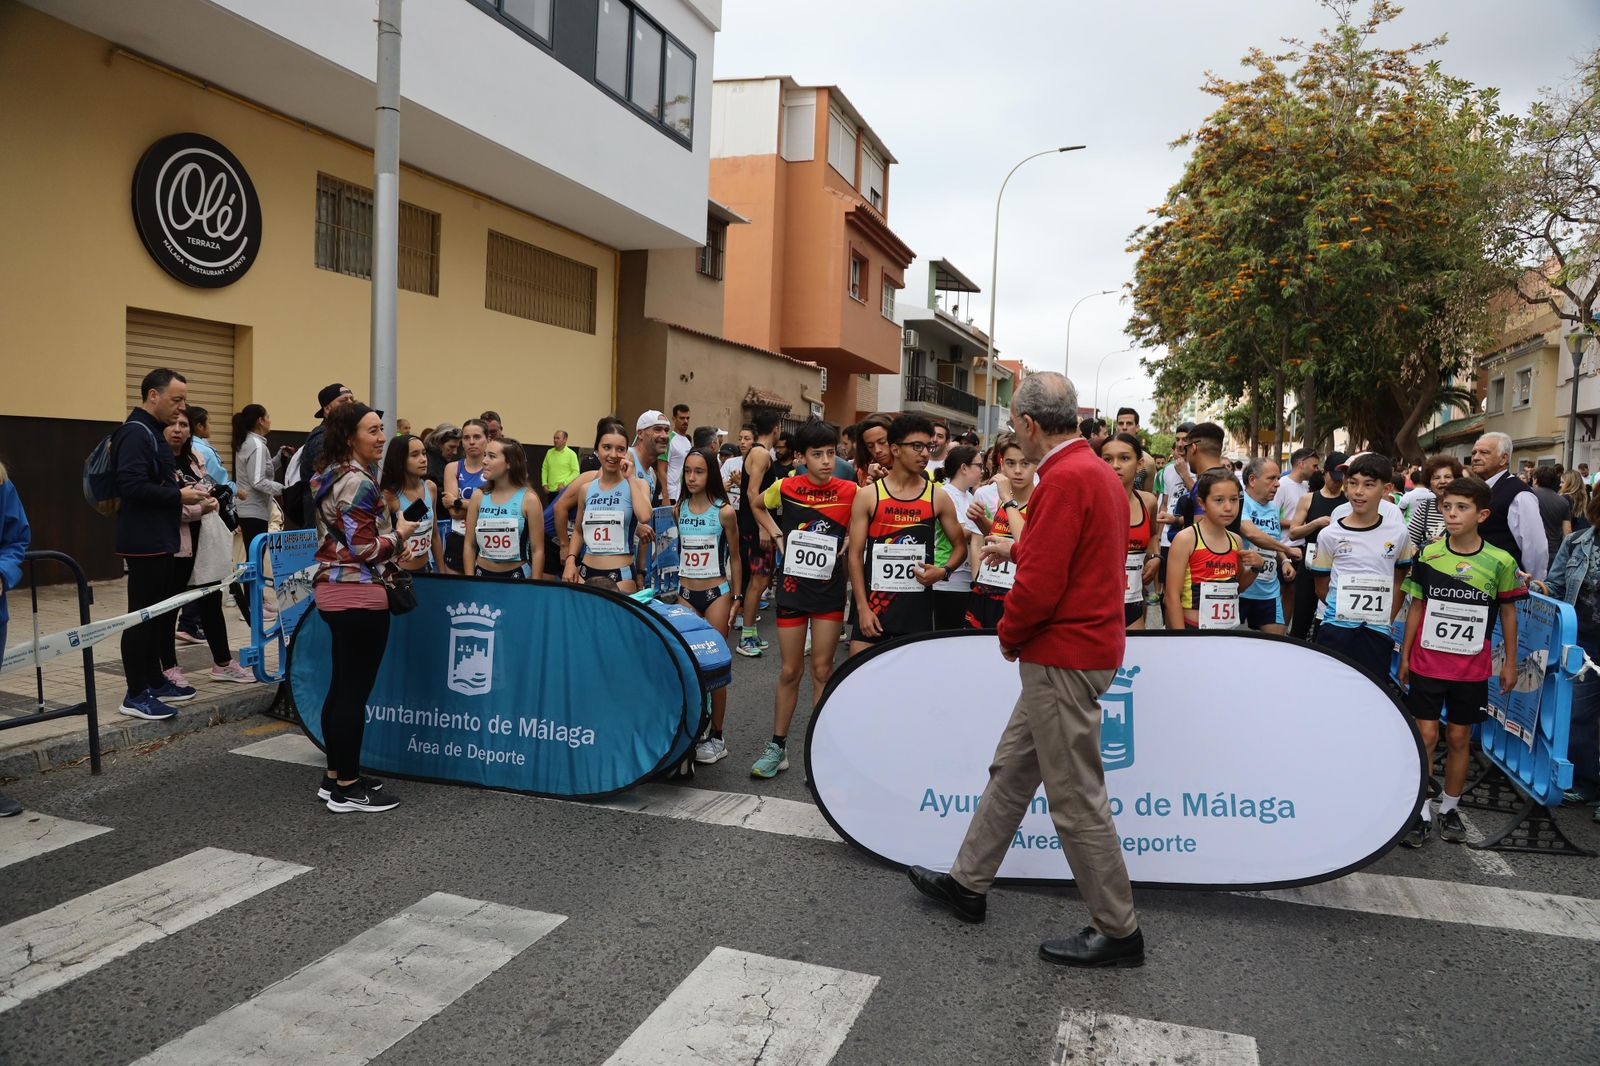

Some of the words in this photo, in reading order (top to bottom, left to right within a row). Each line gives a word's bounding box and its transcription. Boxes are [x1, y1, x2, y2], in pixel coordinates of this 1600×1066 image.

[168, 162, 237, 242] Olé
[186, 236, 221, 251] TERRAZA
[162, 239, 185, 265] MÁLAGA
[188, 264, 226, 276] RESTAURANT
[228, 255, 247, 272] EVENTS
[590, 495, 620, 506] nerja
[480, 505, 508, 516] nerja
[884, 506, 922, 516] Málaga
[895, 514, 921, 522] Bahía
[679, 516, 706, 528] nerja
[1251, 516, 1281, 531] nerja
[484, 535, 511, 549] 296
[593, 527, 611, 541] 61
[684, 552, 710, 567] 297
[795, 549, 827, 568] 900
[1205, 560, 1236, 569] Málaga
[883, 563, 916, 579] 926
[1429, 584, 1489, 602] tecnoaire
[1349, 593, 1384, 612] 721
[1210, 603, 1236, 620] 151
[1435, 621, 1475, 642] 674
[365, 704, 481, 732] yuntamiento
[488, 714, 513, 735] de
[518, 717, 596, 749] Málaga
[407, 734, 440, 755] Área
[444, 742, 462, 757] de
[467, 744, 526, 766] Deporte
[1135, 792, 1172, 816] de
[1182, 791, 1297, 824] Málaga
[1011, 826, 1062, 850] Área
[1117, 834, 1197, 857] eporte
